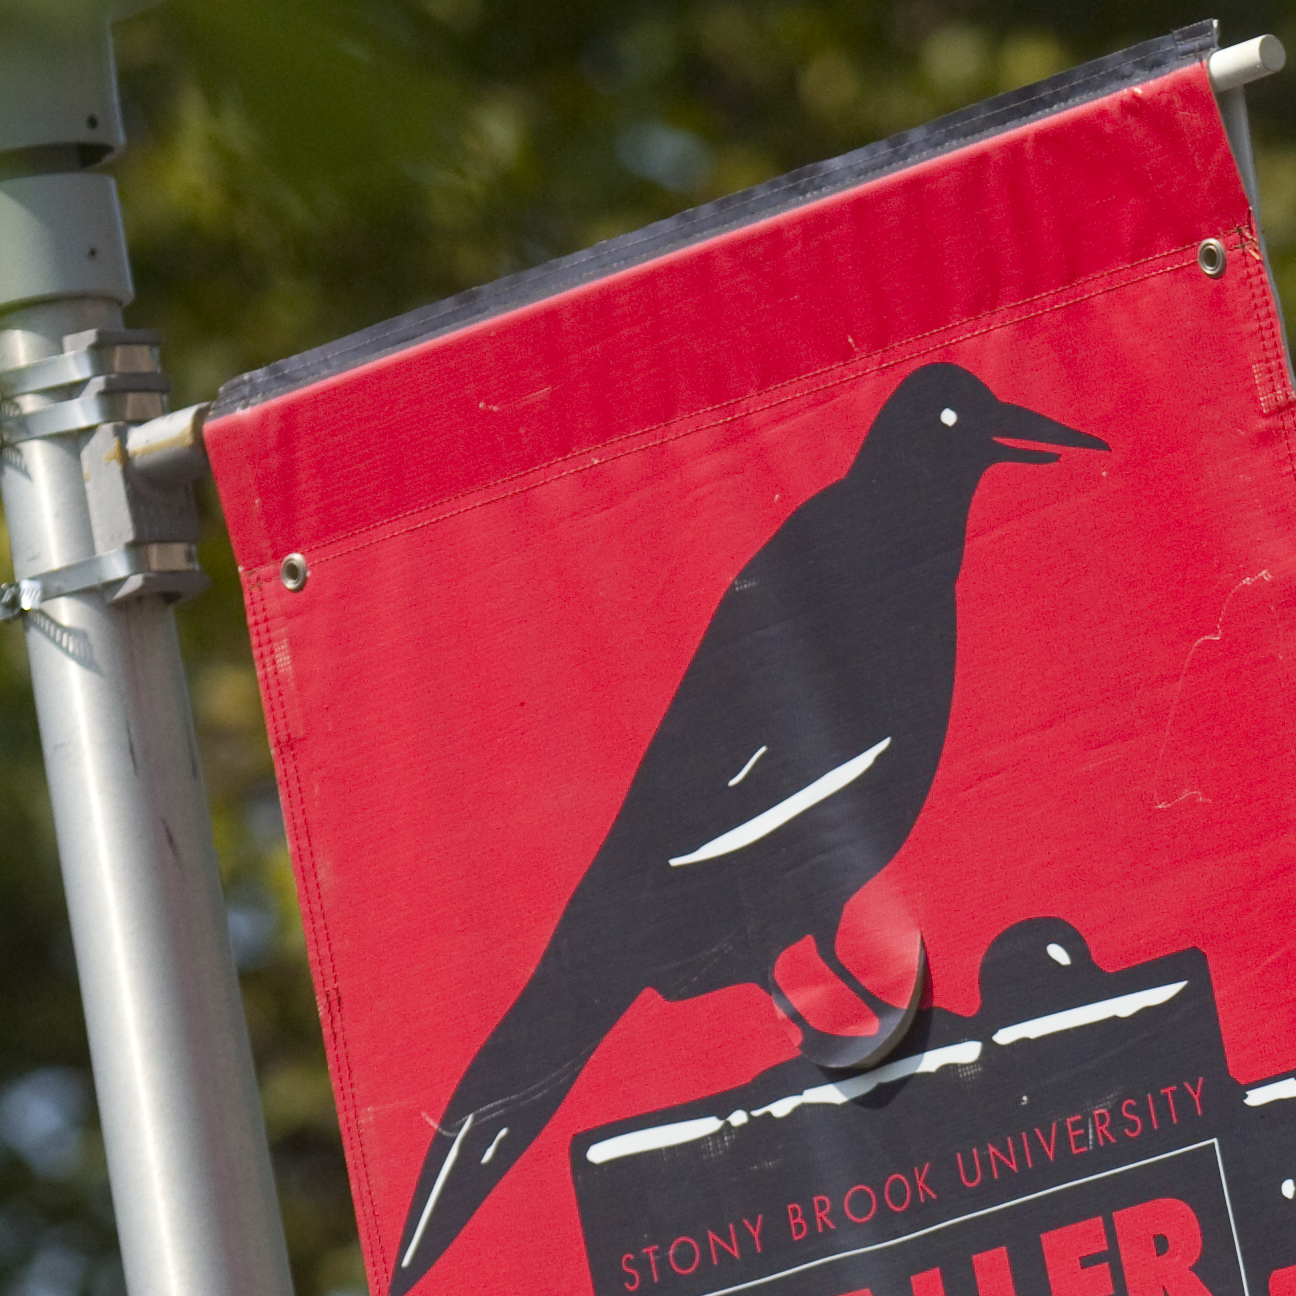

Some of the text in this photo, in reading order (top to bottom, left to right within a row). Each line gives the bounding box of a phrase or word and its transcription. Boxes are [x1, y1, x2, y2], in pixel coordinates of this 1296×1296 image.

[621, 1077, 1205, 1291] STONY BROOK UNIVERSITY
